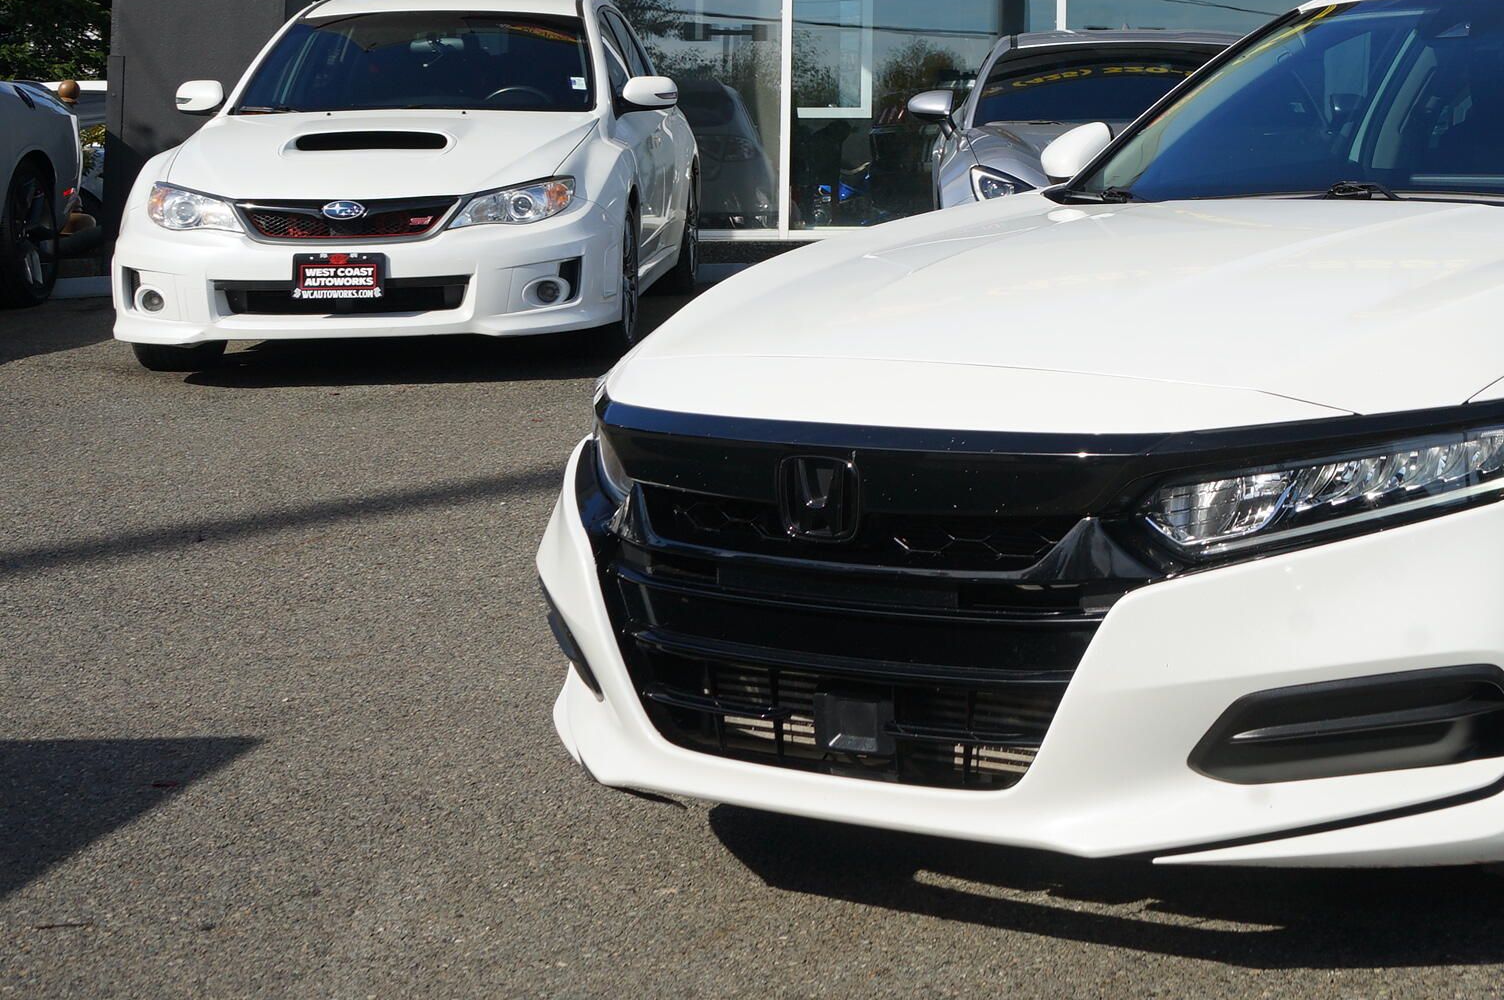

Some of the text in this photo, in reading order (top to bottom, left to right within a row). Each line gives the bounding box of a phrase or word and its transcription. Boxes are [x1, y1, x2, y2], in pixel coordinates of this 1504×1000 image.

[304, 267, 375, 277] WEST COAST
[304, 277, 374, 286] AUTOWORKS
[301, 289, 374, 299] WCAUTOWORKS.COM
